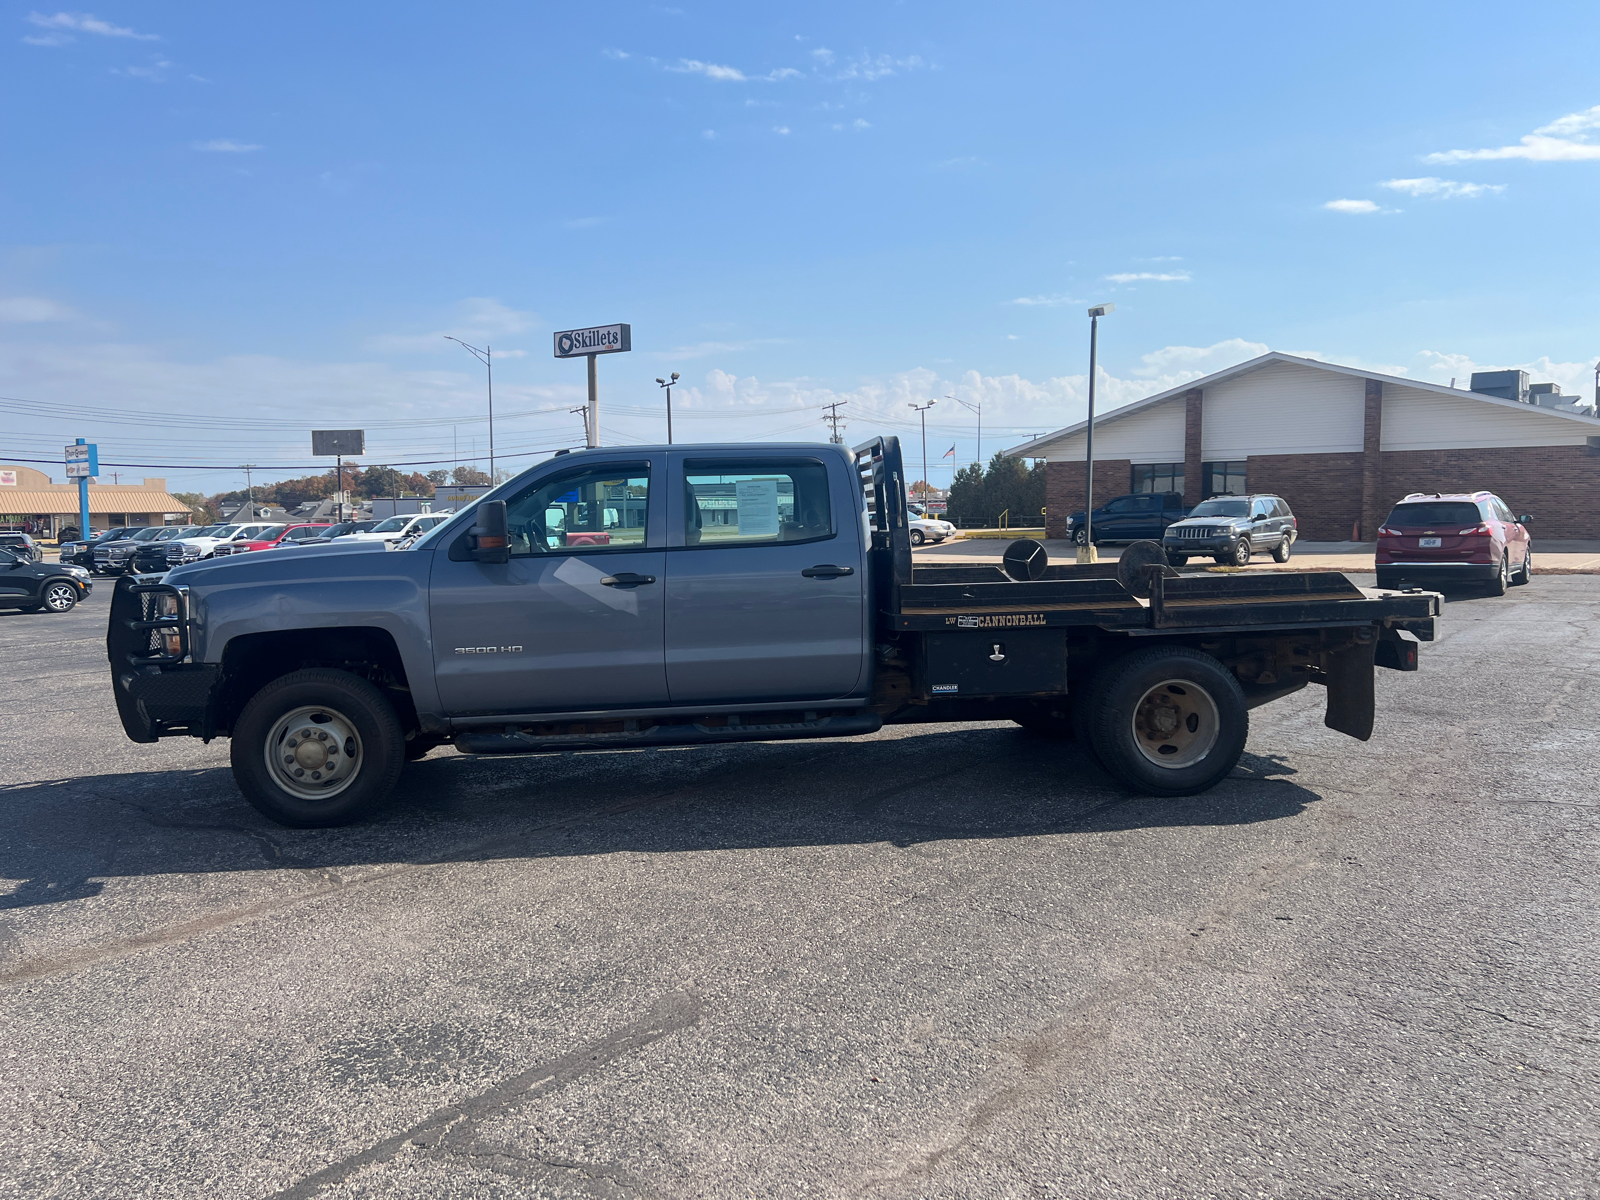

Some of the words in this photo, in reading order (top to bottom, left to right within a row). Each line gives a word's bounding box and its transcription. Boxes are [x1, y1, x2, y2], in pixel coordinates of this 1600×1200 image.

[574, 330, 619, 349] Skillets
[945, 617, 956, 625] LW
[978, 614, 1047, 627] CANNONBALL
[454, 646, 497, 655] 3500
[500, 645, 523, 653] HD
